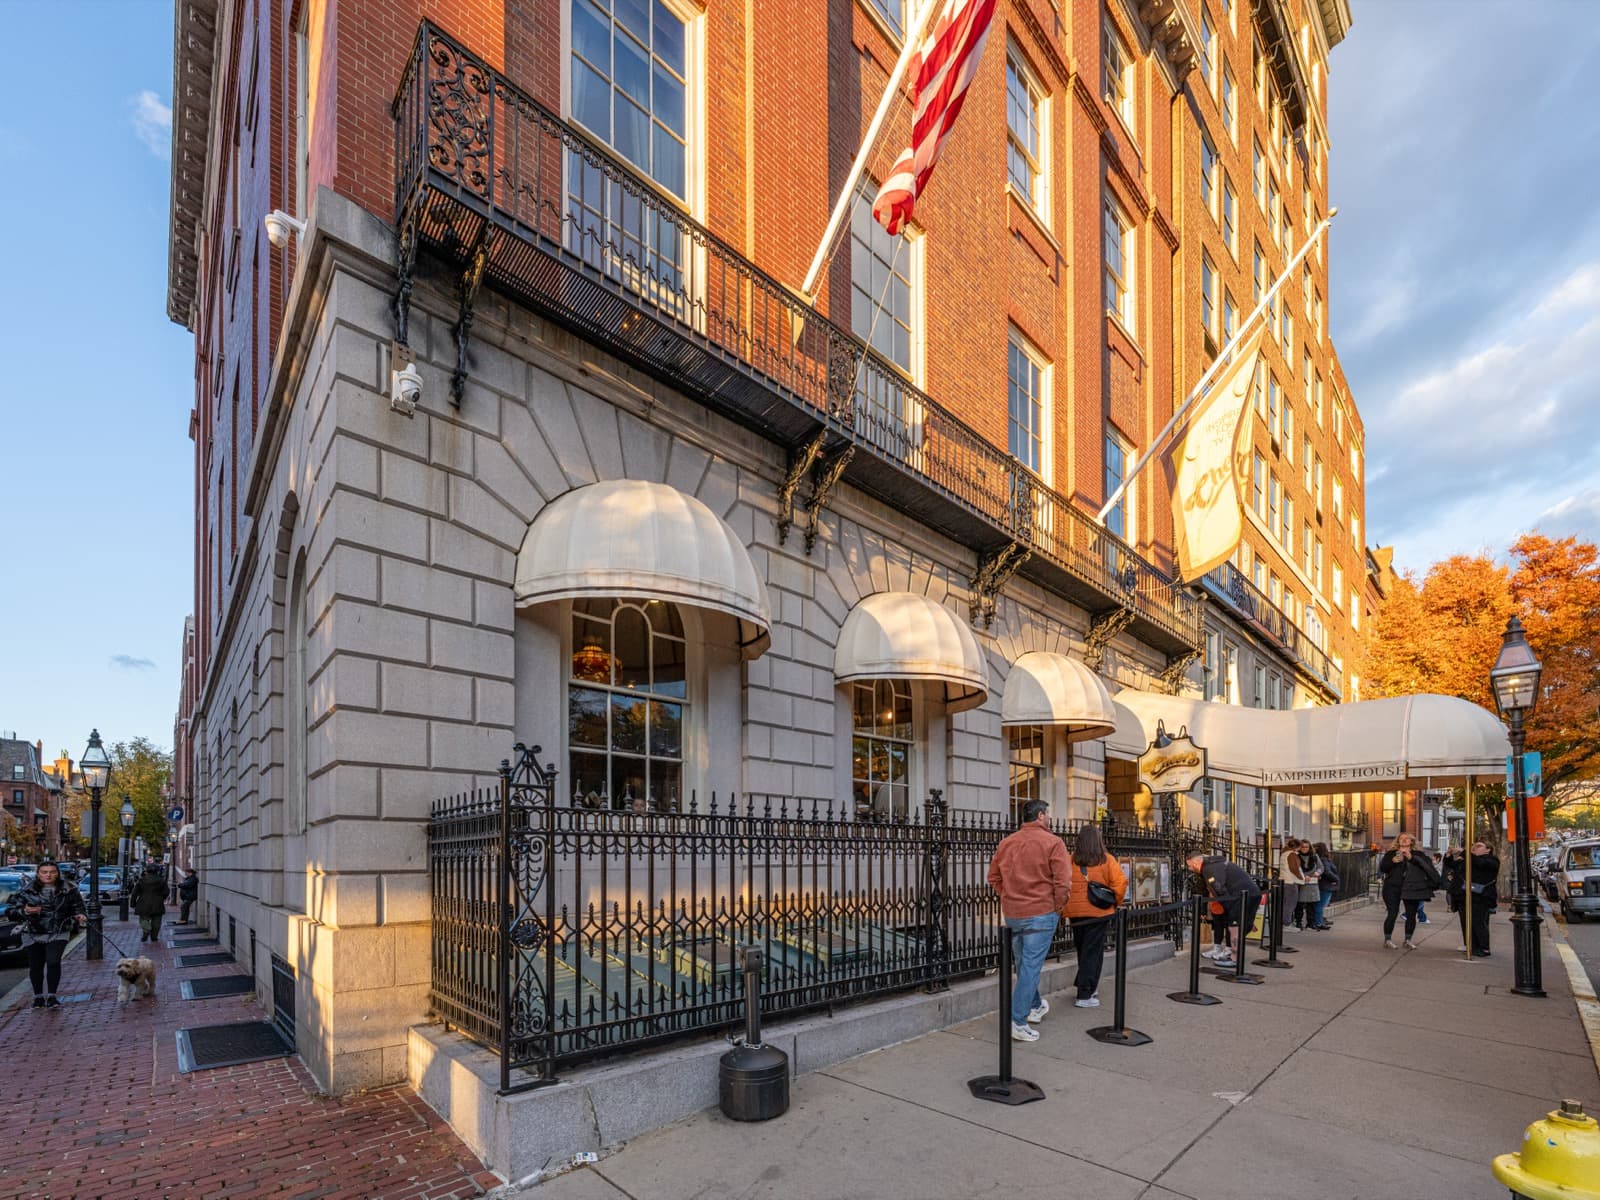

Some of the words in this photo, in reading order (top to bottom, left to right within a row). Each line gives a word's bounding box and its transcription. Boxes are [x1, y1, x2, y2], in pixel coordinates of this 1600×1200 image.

[1265, 769, 1347, 782] HAMPSHIRE
[1351, 765, 1405, 778] HOUSE
[173, 810, 181, 819] P
